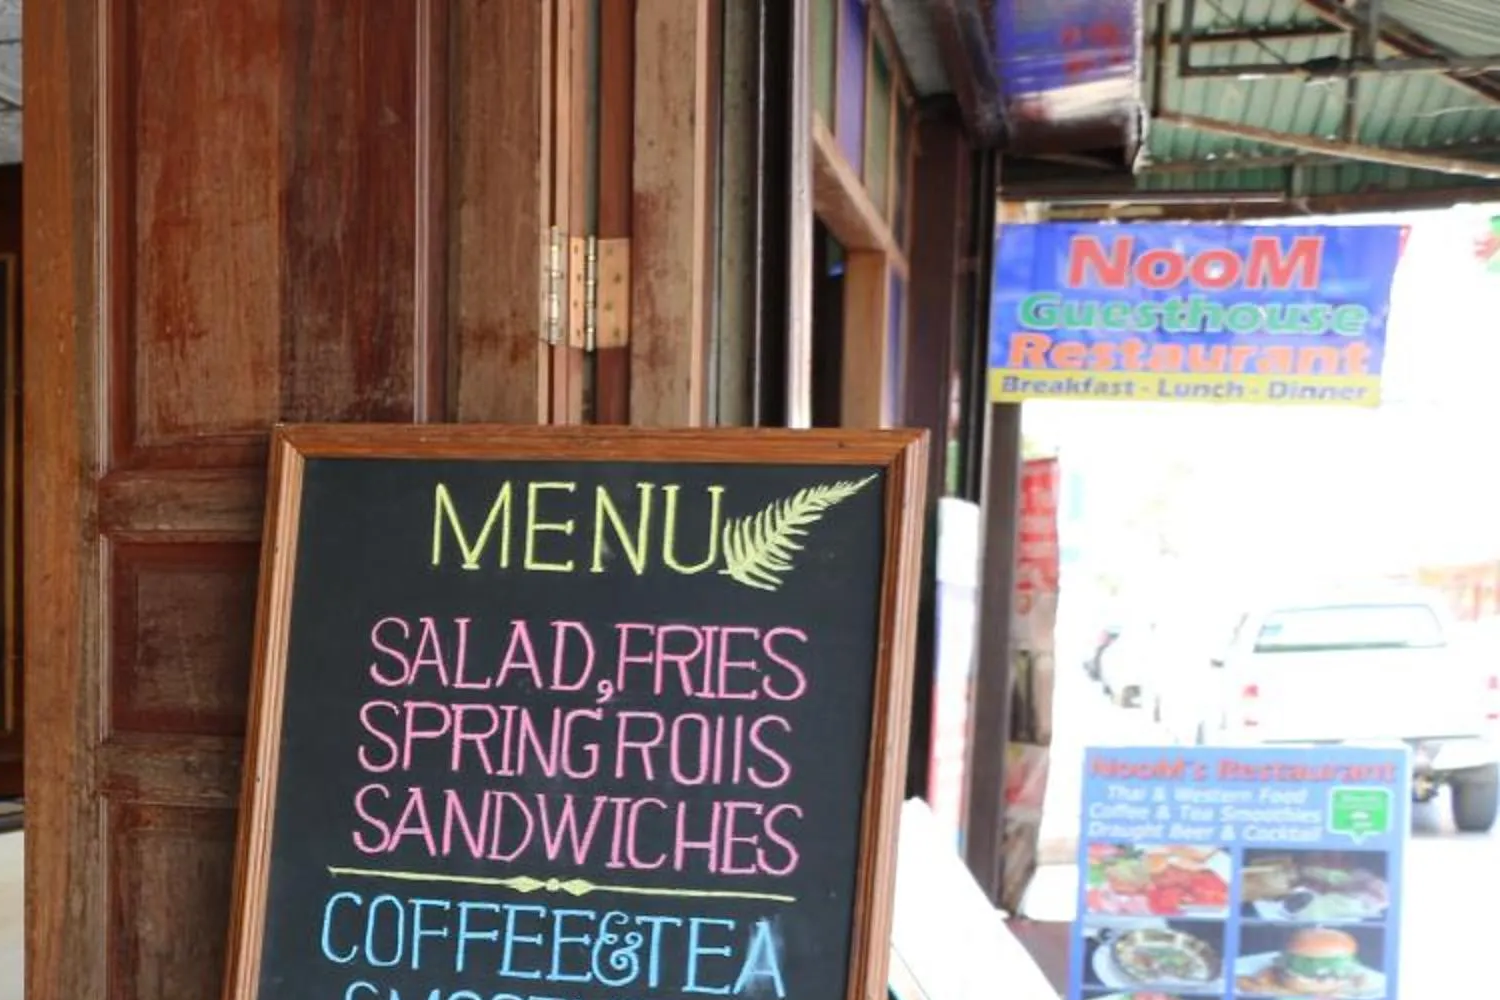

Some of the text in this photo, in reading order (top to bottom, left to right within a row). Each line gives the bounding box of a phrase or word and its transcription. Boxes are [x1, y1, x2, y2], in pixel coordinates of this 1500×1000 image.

[1067, 235, 1324, 290] NooM
[1017, 292, 1369, 337] Guesthouse
[1008, 331, 1371, 376] Restaurant
[1001, 375, 1368, 401] Breakfast Lunch Dinner
[431, 480, 726, 576] MENU
[357, 700, 604, 778] SPRING
[1216, 758, 1396, 783] Restaurant
[351, 783, 803, 876] SANDWICHES
